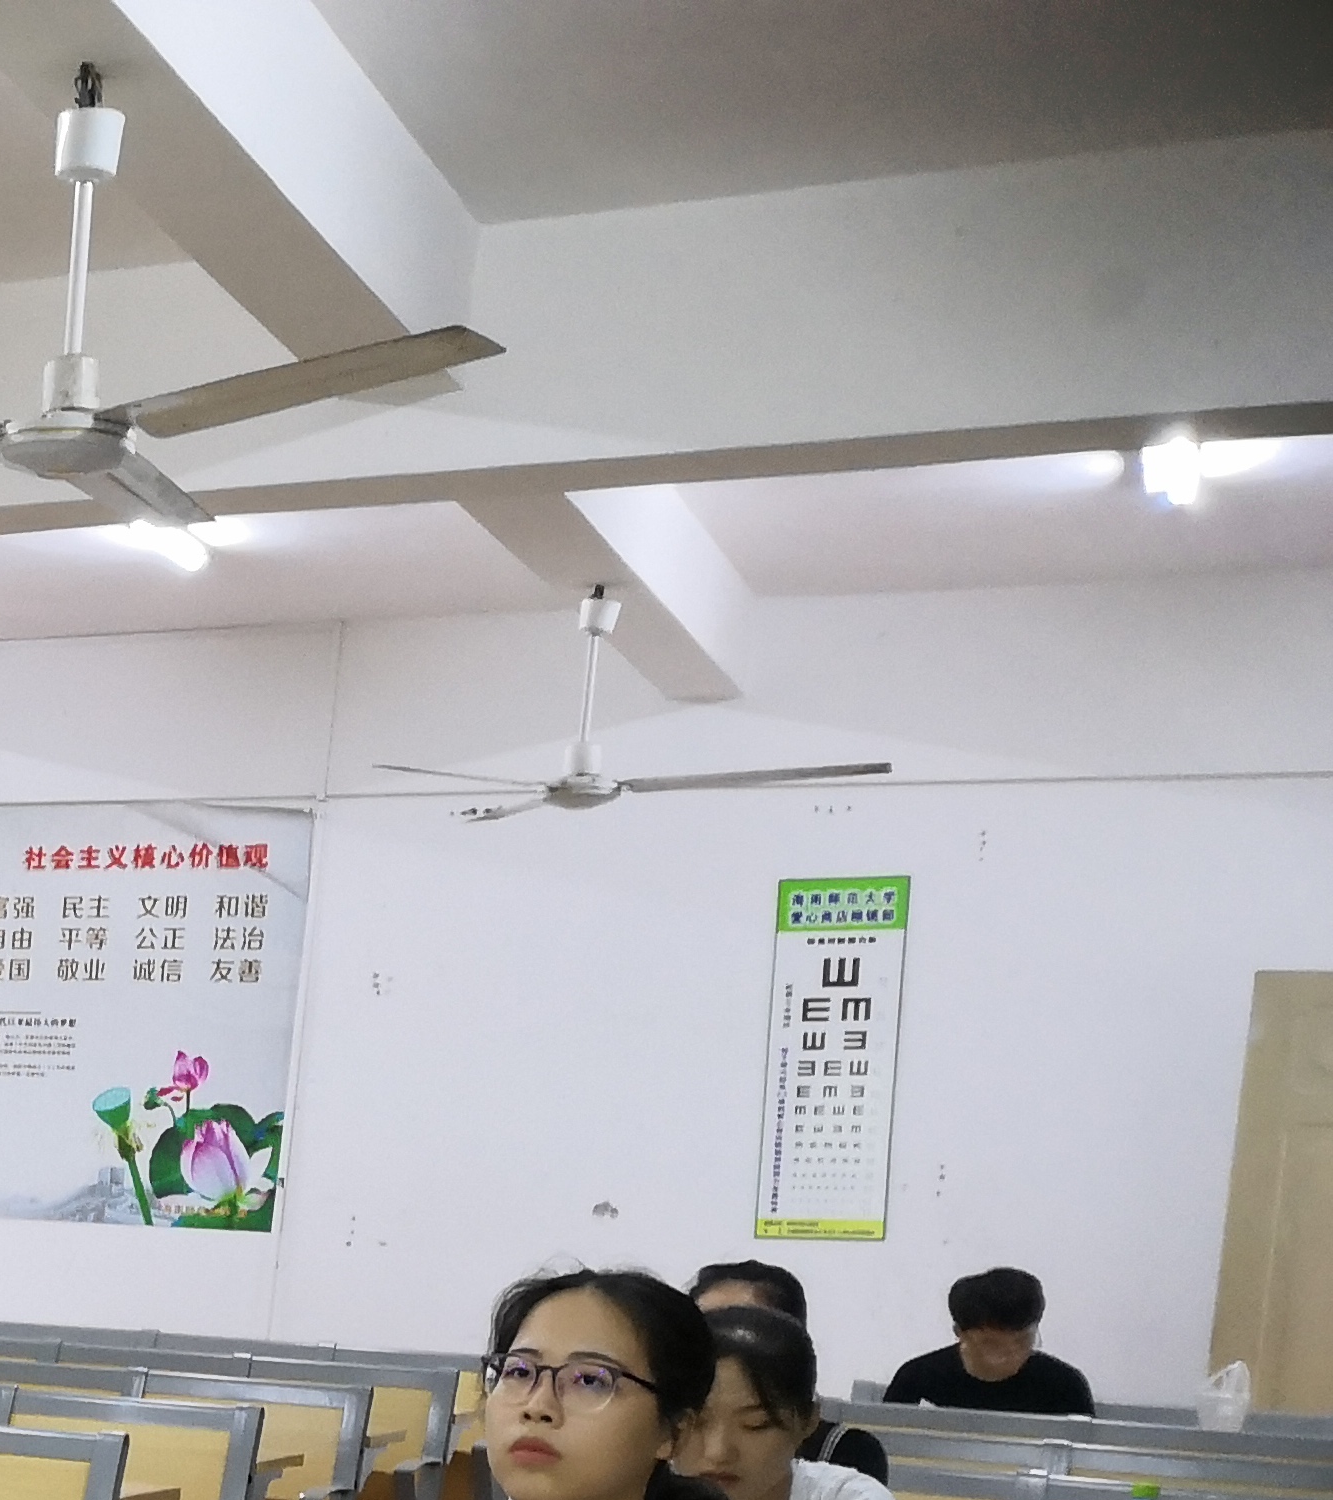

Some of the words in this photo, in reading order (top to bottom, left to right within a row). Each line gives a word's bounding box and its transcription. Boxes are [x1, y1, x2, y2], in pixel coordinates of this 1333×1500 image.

[24, 843, 269, 870] 社会主义核心价值观
[62, 895, 110, 919] 民主
[137, 895, 188, 919] 文明
[215, 894, 268, 919] 和谐
[59, 927, 108, 950] 平等
[136, 927, 185, 950] 公正
[213, 926, 265, 951] 法治
[57, 958, 105, 982] 敬业
[133, 958, 183, 982] 诚信
[210, 958, 262, 983] 友善
